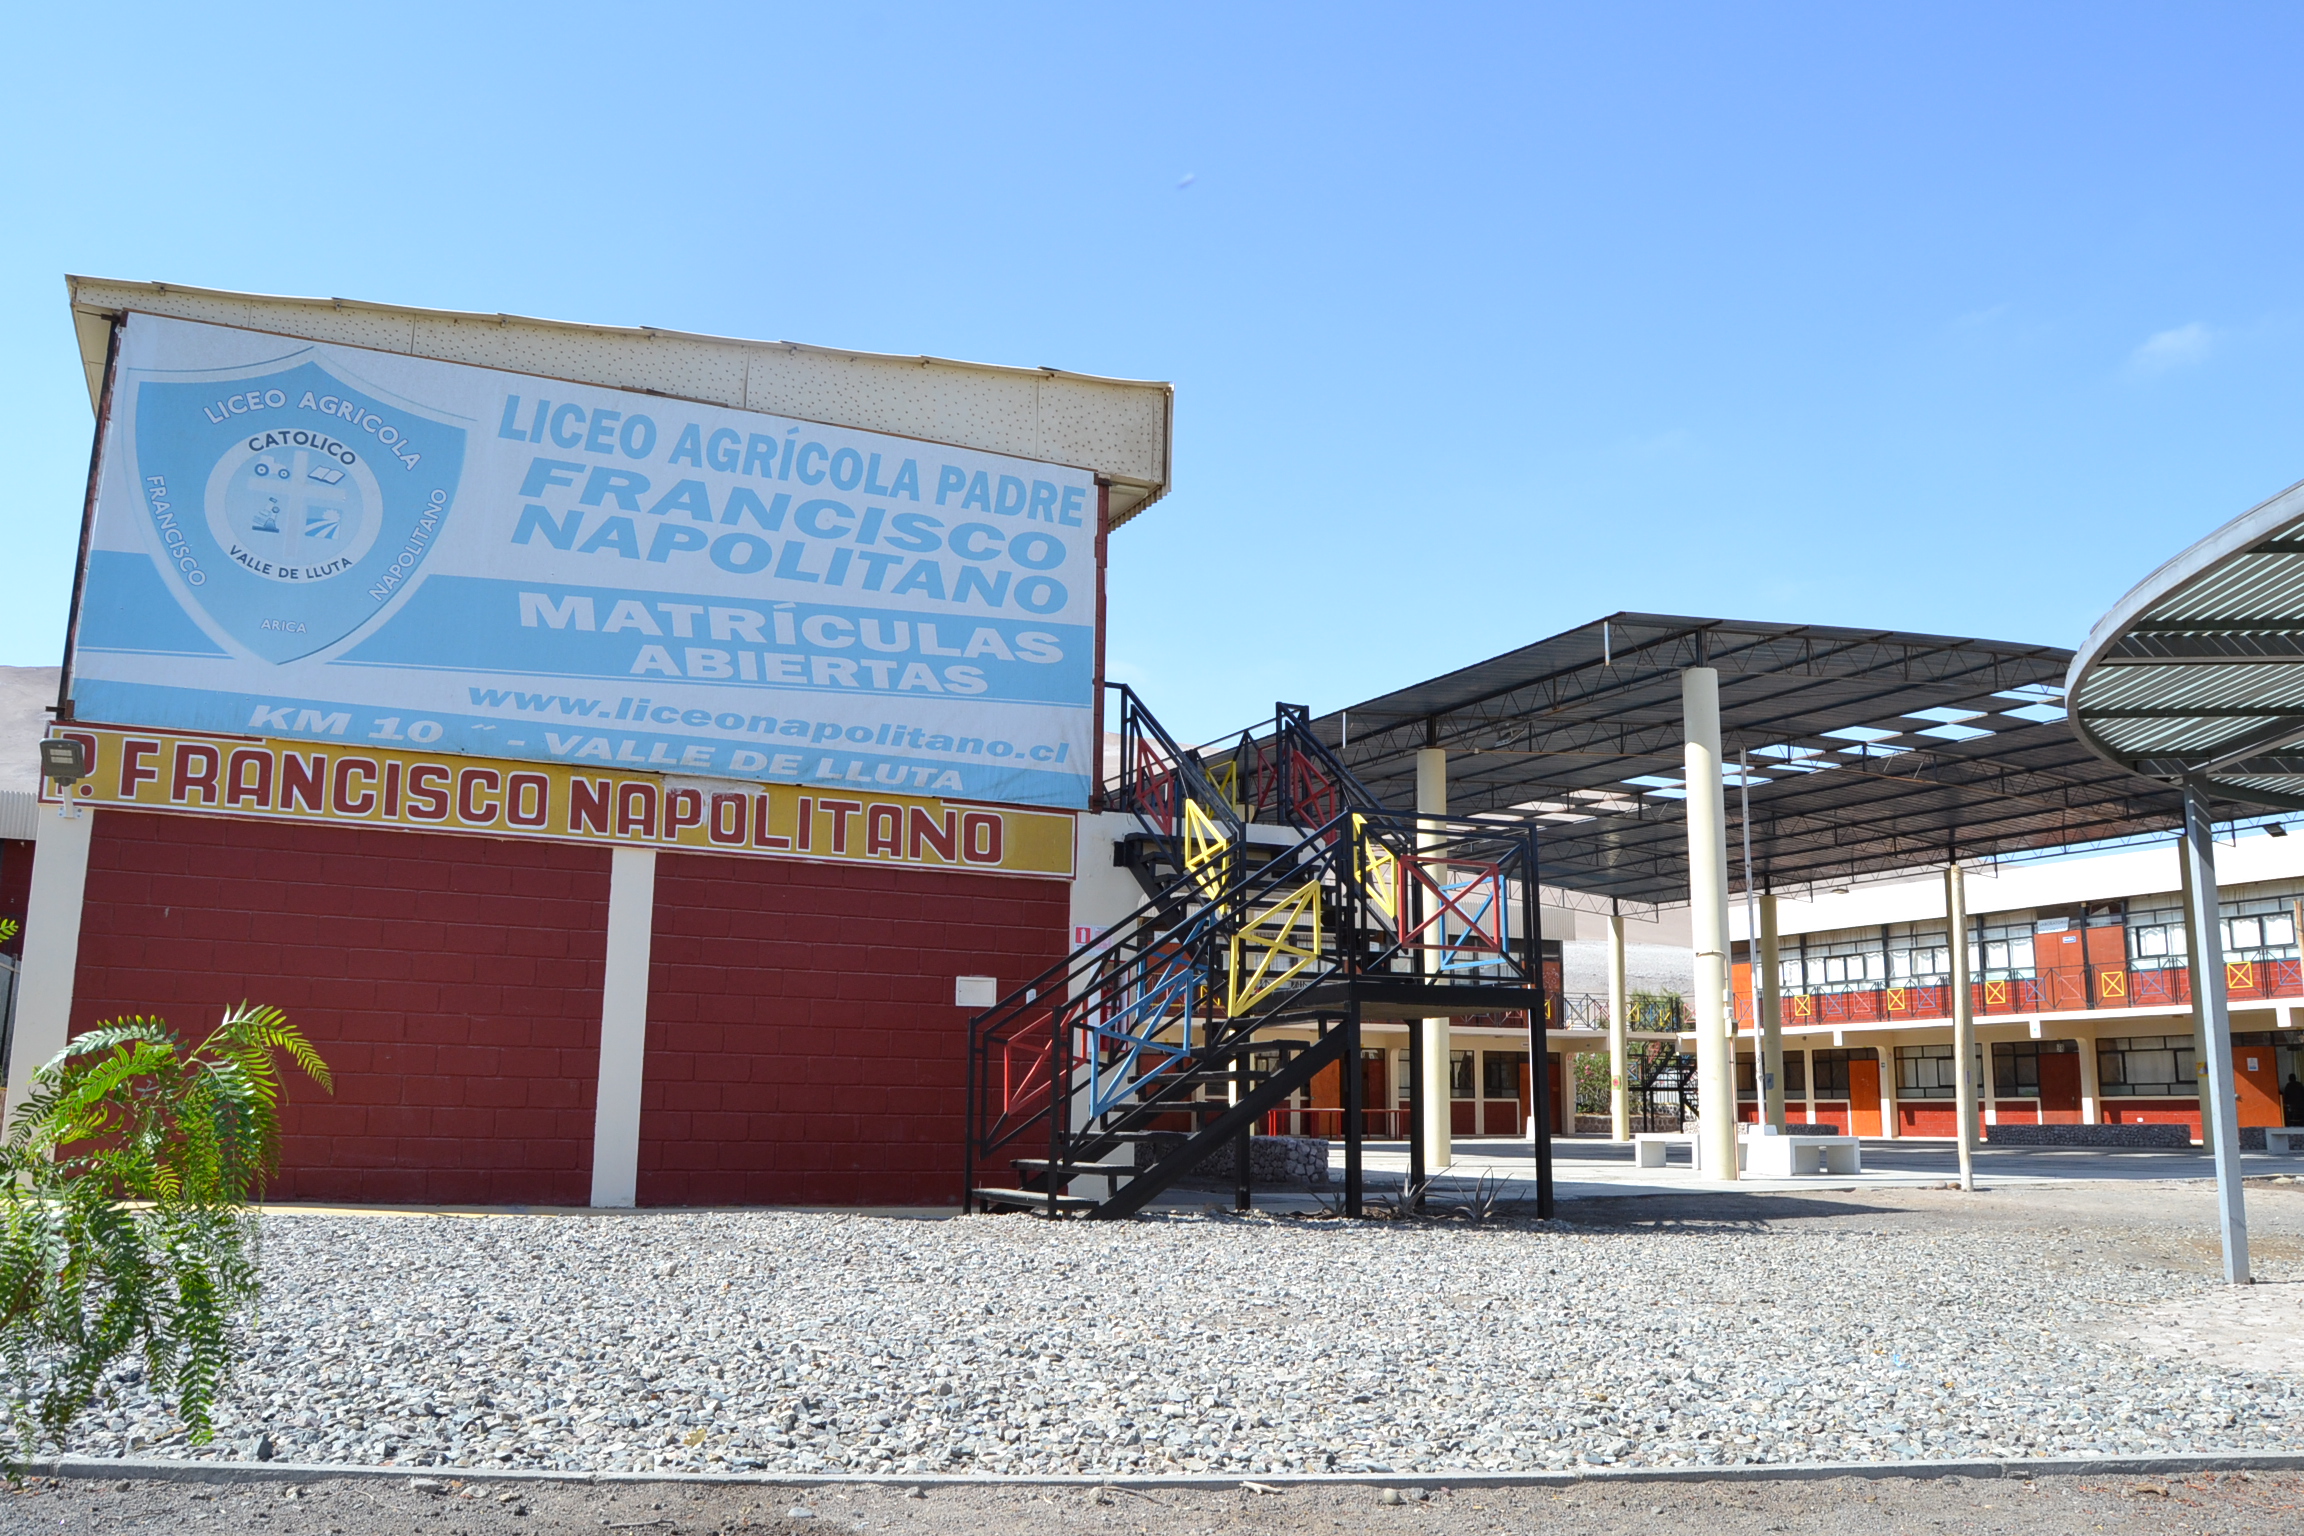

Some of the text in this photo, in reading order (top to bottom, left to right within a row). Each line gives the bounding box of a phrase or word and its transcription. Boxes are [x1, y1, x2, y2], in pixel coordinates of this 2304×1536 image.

[203, 389, 422, 471] LICEO AGRICOLA
[249, 430, 356, 465] CATOLICO
[497, 394, 1086, 528] LICEO AGRÍCOLA PADRE
[146, 475, 207, 586] FRANCISCO
[368, 488, 447, 602] NAPOLITANO
[518, 456, 1067, 570] FRANCISCO
[230, 544, 352, 579] VALLE DE LLUTA
[510, 503, 1069, 615] NAPOLITANO
[260, 618, 307, 634] ARICA
[518, 591, 1064, 664] MATRÍCULAS
[630, 644, 989, 695] ABIERTAS
[248, 705, 351, 735] KM
[368, 717, 444, 743] 10
[544, 732, 727, 770] VALLE
[730, 750, 800, 777] DE
[816, 757, 963, 791] LLUTA
[467, 686, 1070, 764] www.liceonapolitano.cl
[118, 737, 550, 831] FRANCISCO
[567, 775, 1004, 866] NAPOLITANO
